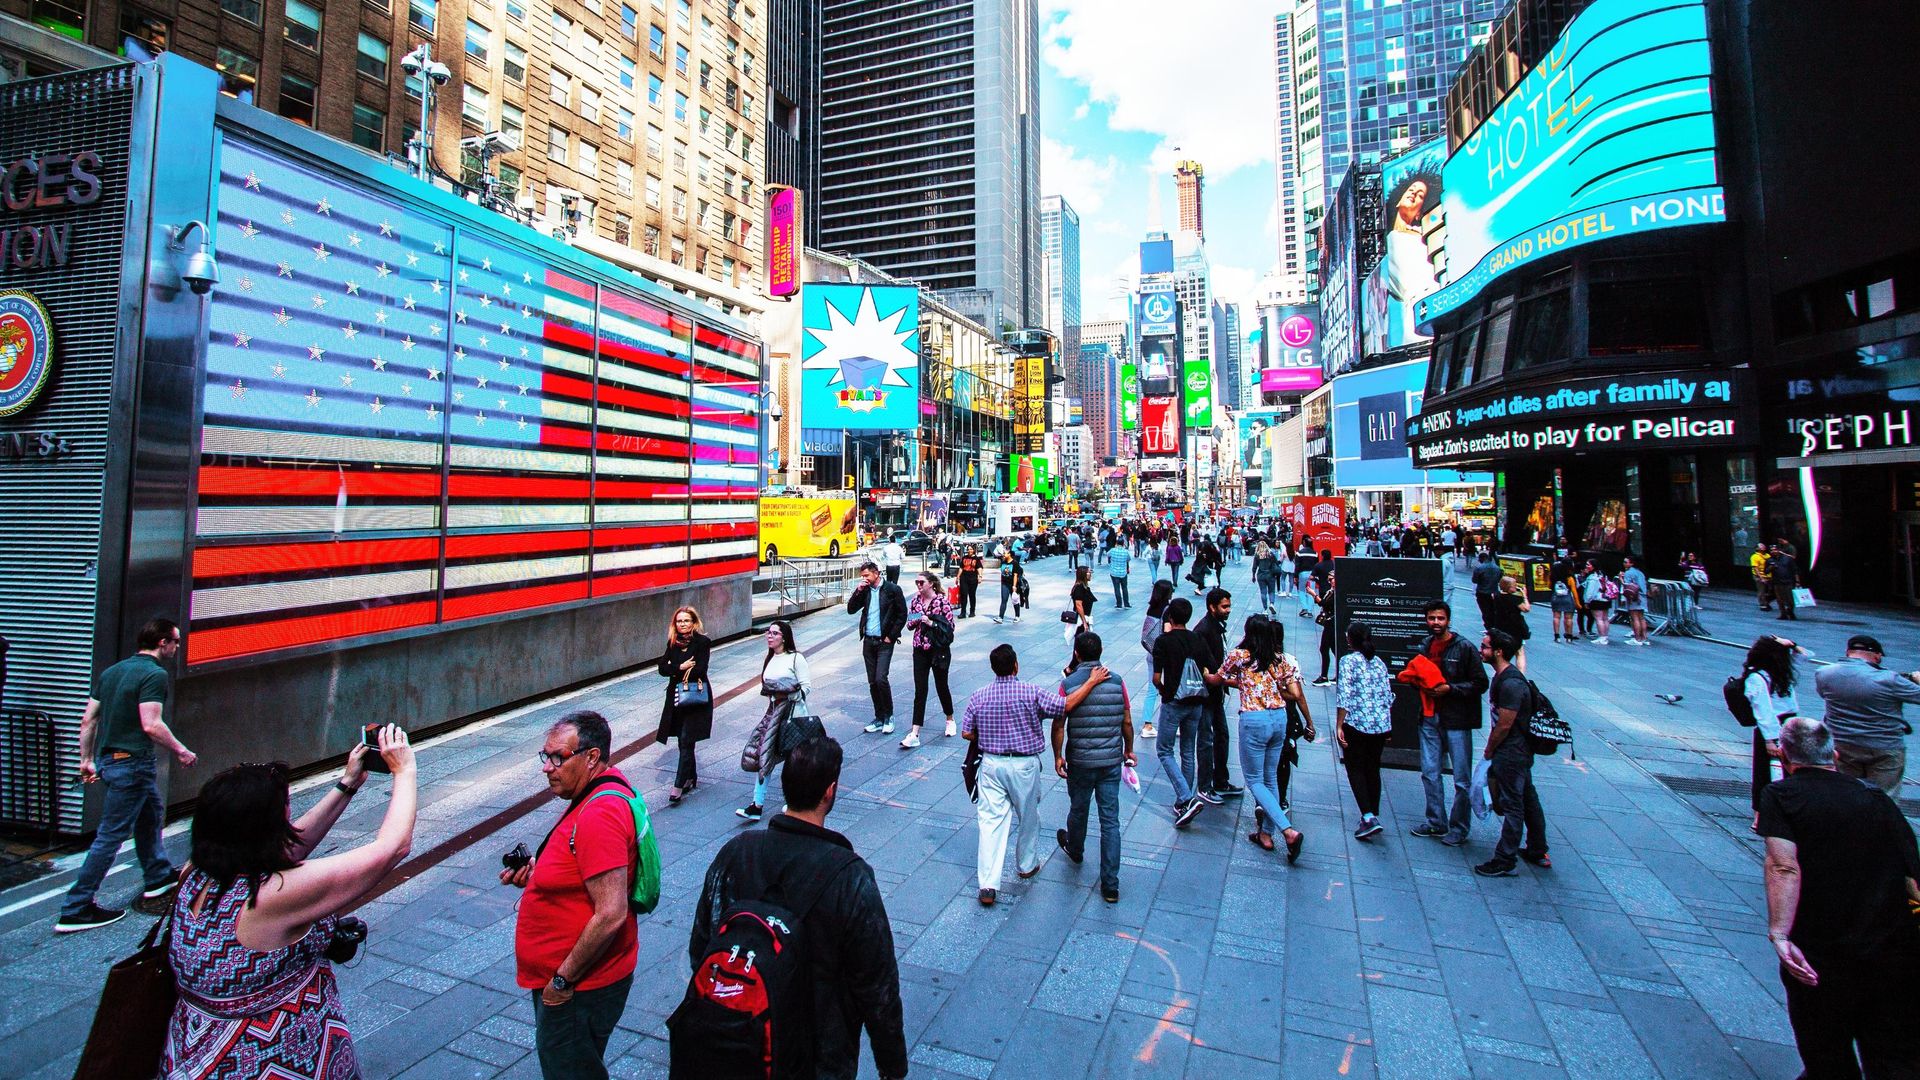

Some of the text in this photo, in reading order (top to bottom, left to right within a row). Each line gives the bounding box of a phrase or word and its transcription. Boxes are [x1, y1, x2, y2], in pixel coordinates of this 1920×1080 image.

[1487, 62, 1594, 191] HOTEL
[0, 152, 103, 210] CES
[1489, 239, 1533, 275] GRAND
[1537, 212, 1615, 251] HOTEL
[31, 314, 44, 342] NAVY
[1283, 349, 1313, 367] LG
[1029, 377, 1043, 386] KING
[1456, 398, 1506, 426] 2-year-old
[1508, 396, 1542, 415] dies
[1545, 388, 1601, 410] after
[1606, 378, 1697, 404] family
[1368, 411, 1398, 443] GAP
[1418, 438, 1443, 462] Stepdad:
[1444, 437, 1469, 456] Zion's
[1469, 431, 1510, 453] excited
[1512, 431, 1530, 448] to
[1533, 426, 1579, 450] play
[1584, 422, 1626, 443] for
[1311, 502, 1335, 516] DESIGN
[1311, 513, 1340, 527] PAVILION
[1374, 598, 1391, 606] SEA
